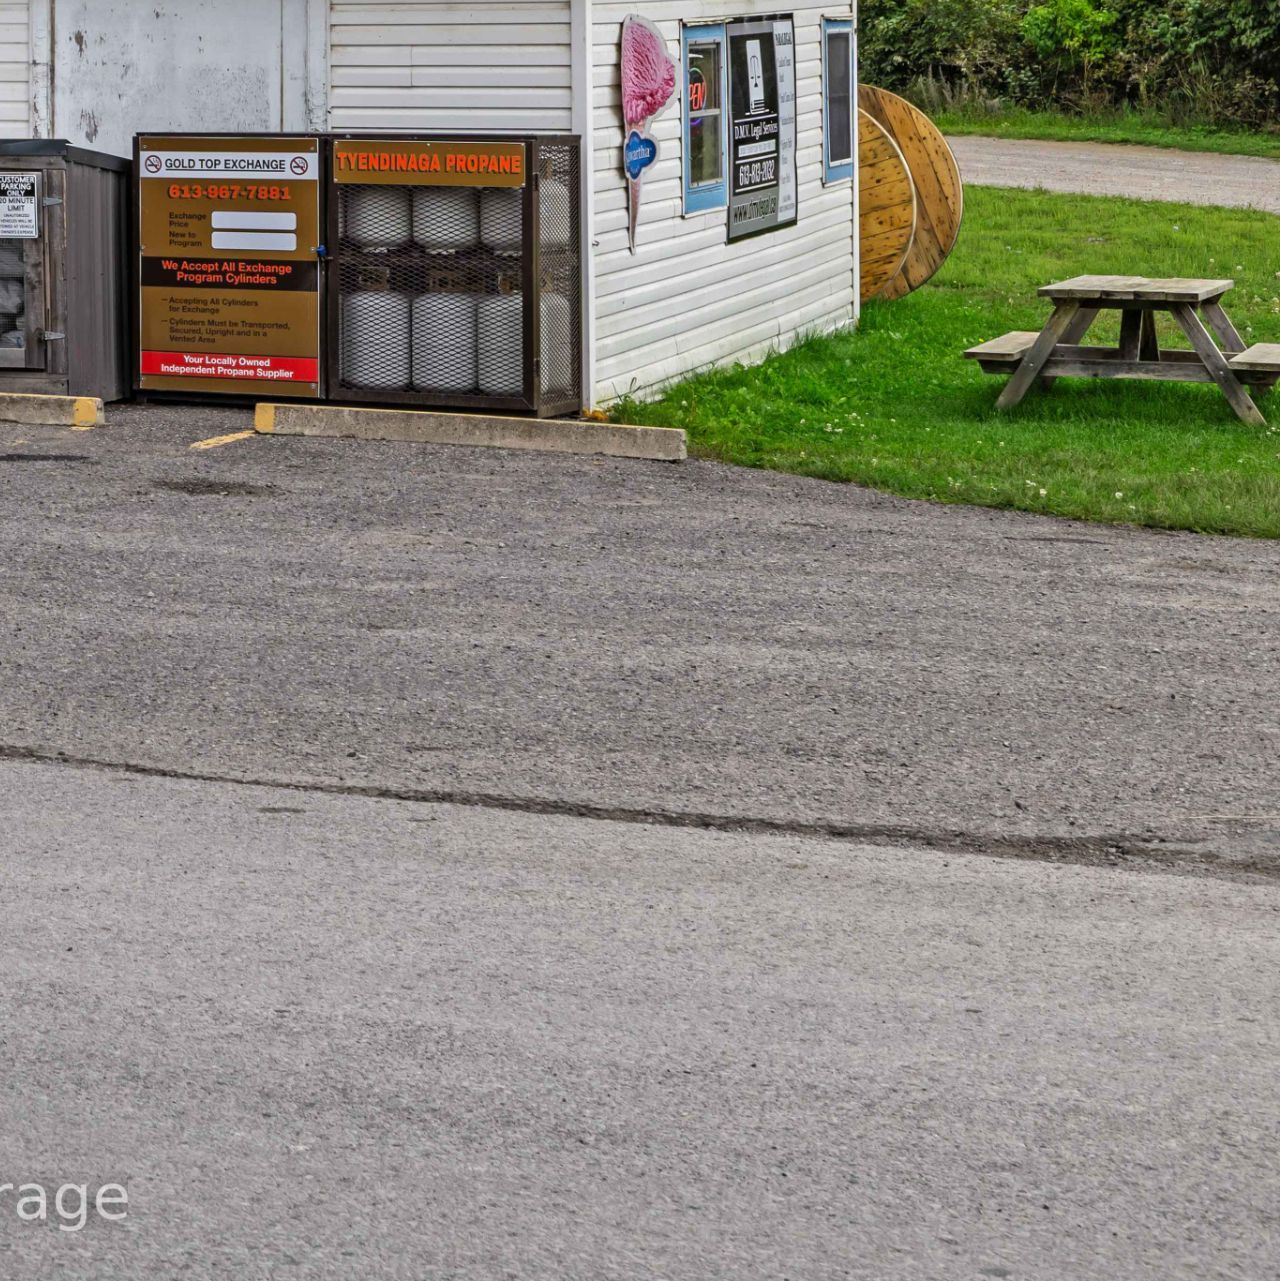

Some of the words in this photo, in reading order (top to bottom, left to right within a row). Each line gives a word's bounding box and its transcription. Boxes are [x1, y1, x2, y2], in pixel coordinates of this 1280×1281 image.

[689, 83, 705, 109] PEN
[165, 159, 196, 169] GOLD
[199, 159, 221, 169] TOP
[224, 160, 286, 170] EXCHANGE
[338, 152, 440, 173] TYENDINAGA
[445, 154, 521, 174] PROPANE
[168, 184, 291, 200] 613-967-7881
[169, 212, 207, 220] Exchange
[169, 220, 188, 228] Price
[169, 240, 202, 249] Program
[162, 260, 179, 269] We
[181, 261, 219, 272] Accept
[222, 262, 236, 271] All
[238, 263, 292, 275] Exchange
[177, 271, 223, 284] Program
[226, 272, 277, 285] Cylinders
[169, 296, 208, 307] Accepting
[210, 297, 220, 305] All
[223, 298, 259, 308] Cylinders
[182, 306, 220, 315] Exchange
[169, 318, 206, 327] Cylinders
[241, 321, 290, 330] Transported,
[169, 326, 203, 335] Secured,
[205, 328, 234, 337] Upright
[236, 329, 252, 337] and
[198, 336, 216, 344] Area
[183, 354, 203, 364] Your
[205, 356, 236, 366] Locally
[239, 358, 270, 367] Owned
[161, 363, 215, 375] Independent
[218, 367, 254, 377] Propane
[256, 368, 294, 379] Supplier
